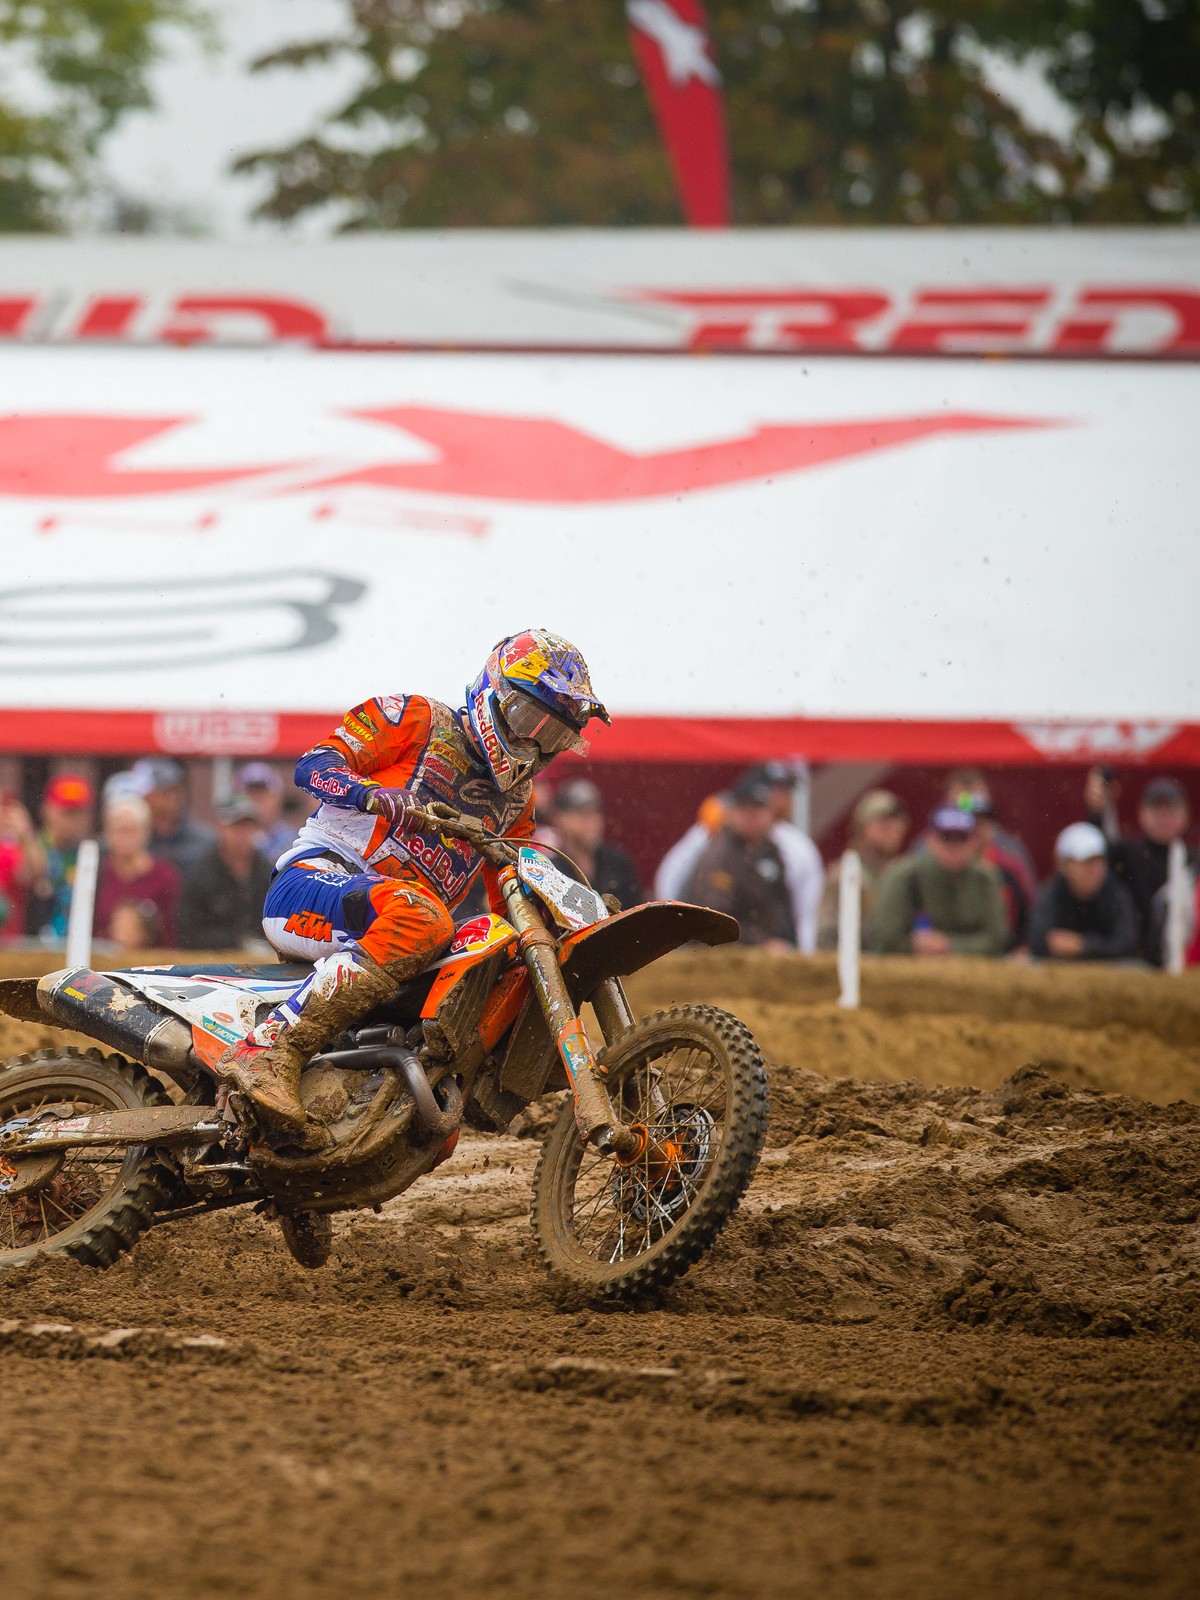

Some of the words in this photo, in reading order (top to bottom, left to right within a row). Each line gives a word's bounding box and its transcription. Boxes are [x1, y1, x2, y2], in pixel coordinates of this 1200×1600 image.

[343, 714, 374, 742] UMBO
[283, 909, 335, 943] KTM
[214, 1027, 241, 1043] MOTO
